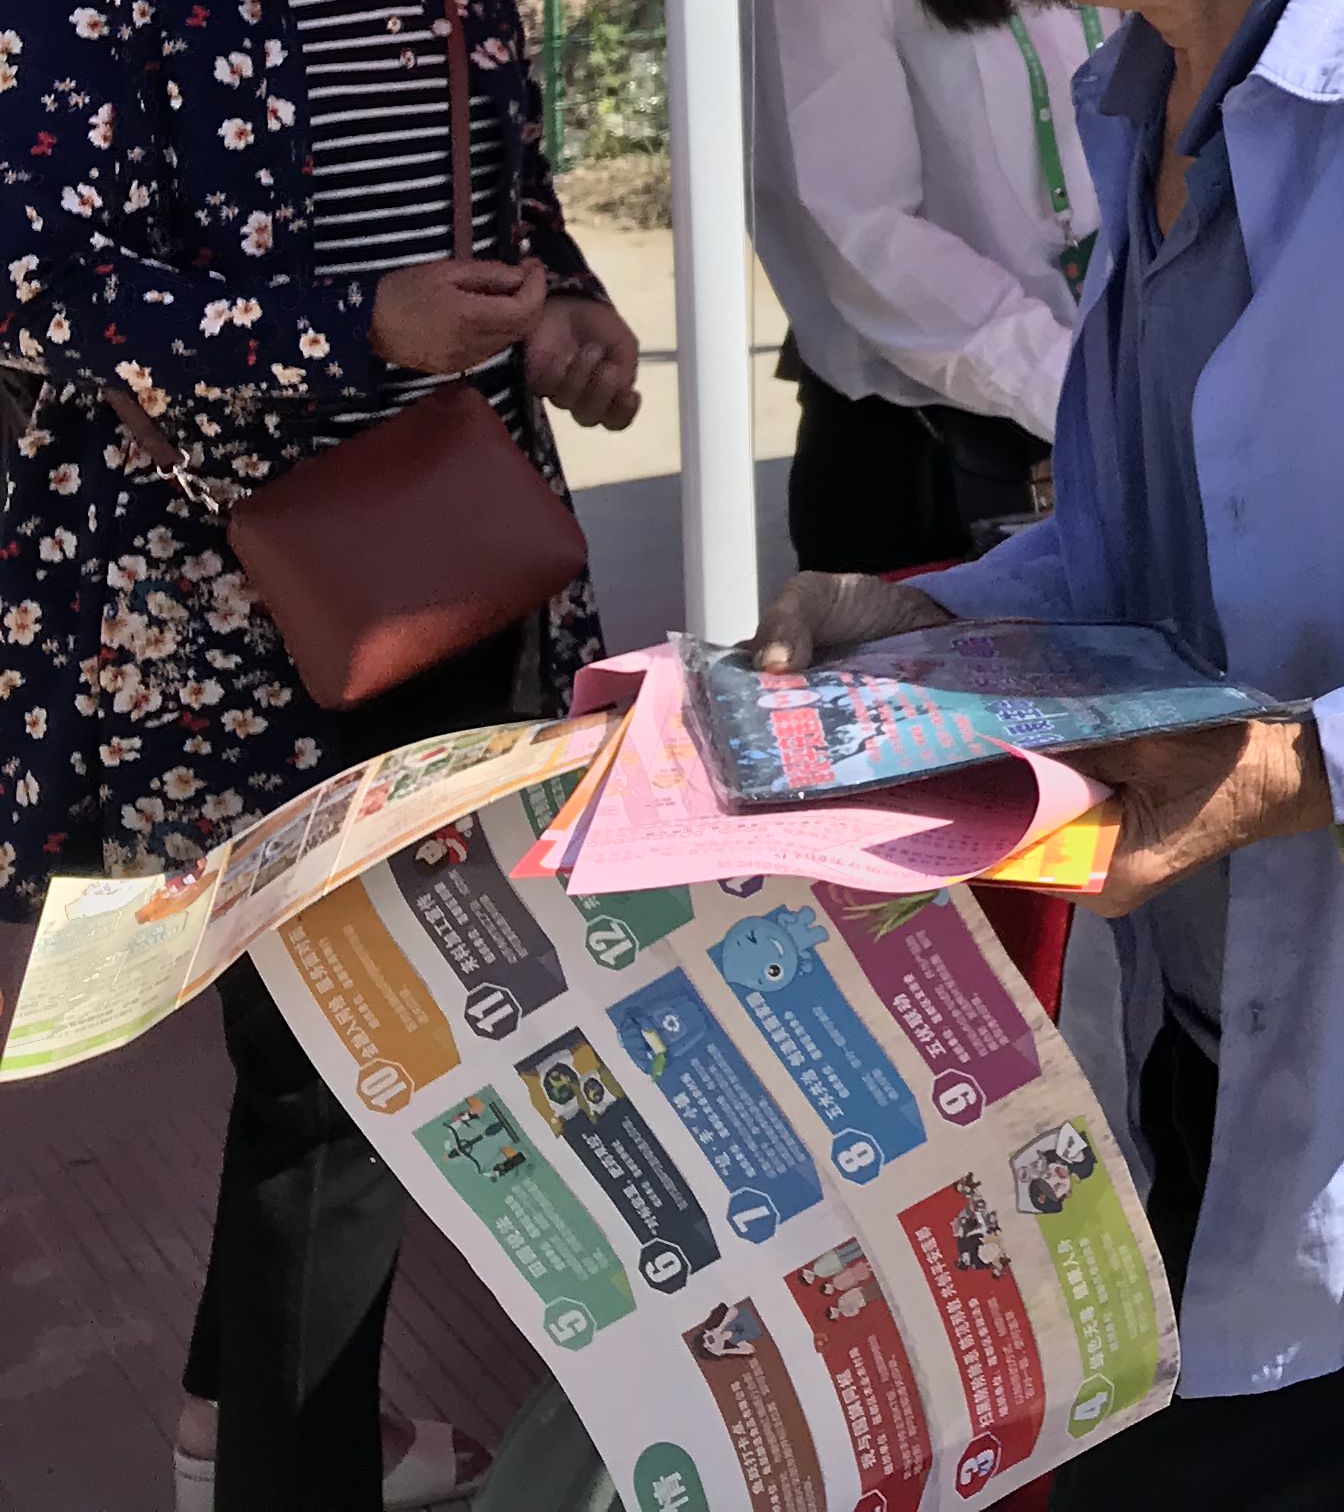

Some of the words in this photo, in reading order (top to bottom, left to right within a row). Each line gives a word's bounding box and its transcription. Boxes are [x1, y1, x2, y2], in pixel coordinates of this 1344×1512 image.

[585, 919, 633, 968] 12
[465, 988, 515, 1036] 11
[890, 991, 946, 1059] 五优联动
[357, 1062, 408, 1113] 10
[935, 1078, 979, 1117] 9
[835, 1138, 878, 1176] 8
[731, 1203, 771, 1233] 7
[643, 1248, 683, 1285] 6
[547, 1307, 589, 1344] 5
[1072, 1390, 1106, 1421] 4
[956, 1447, 995, 1484] 3
